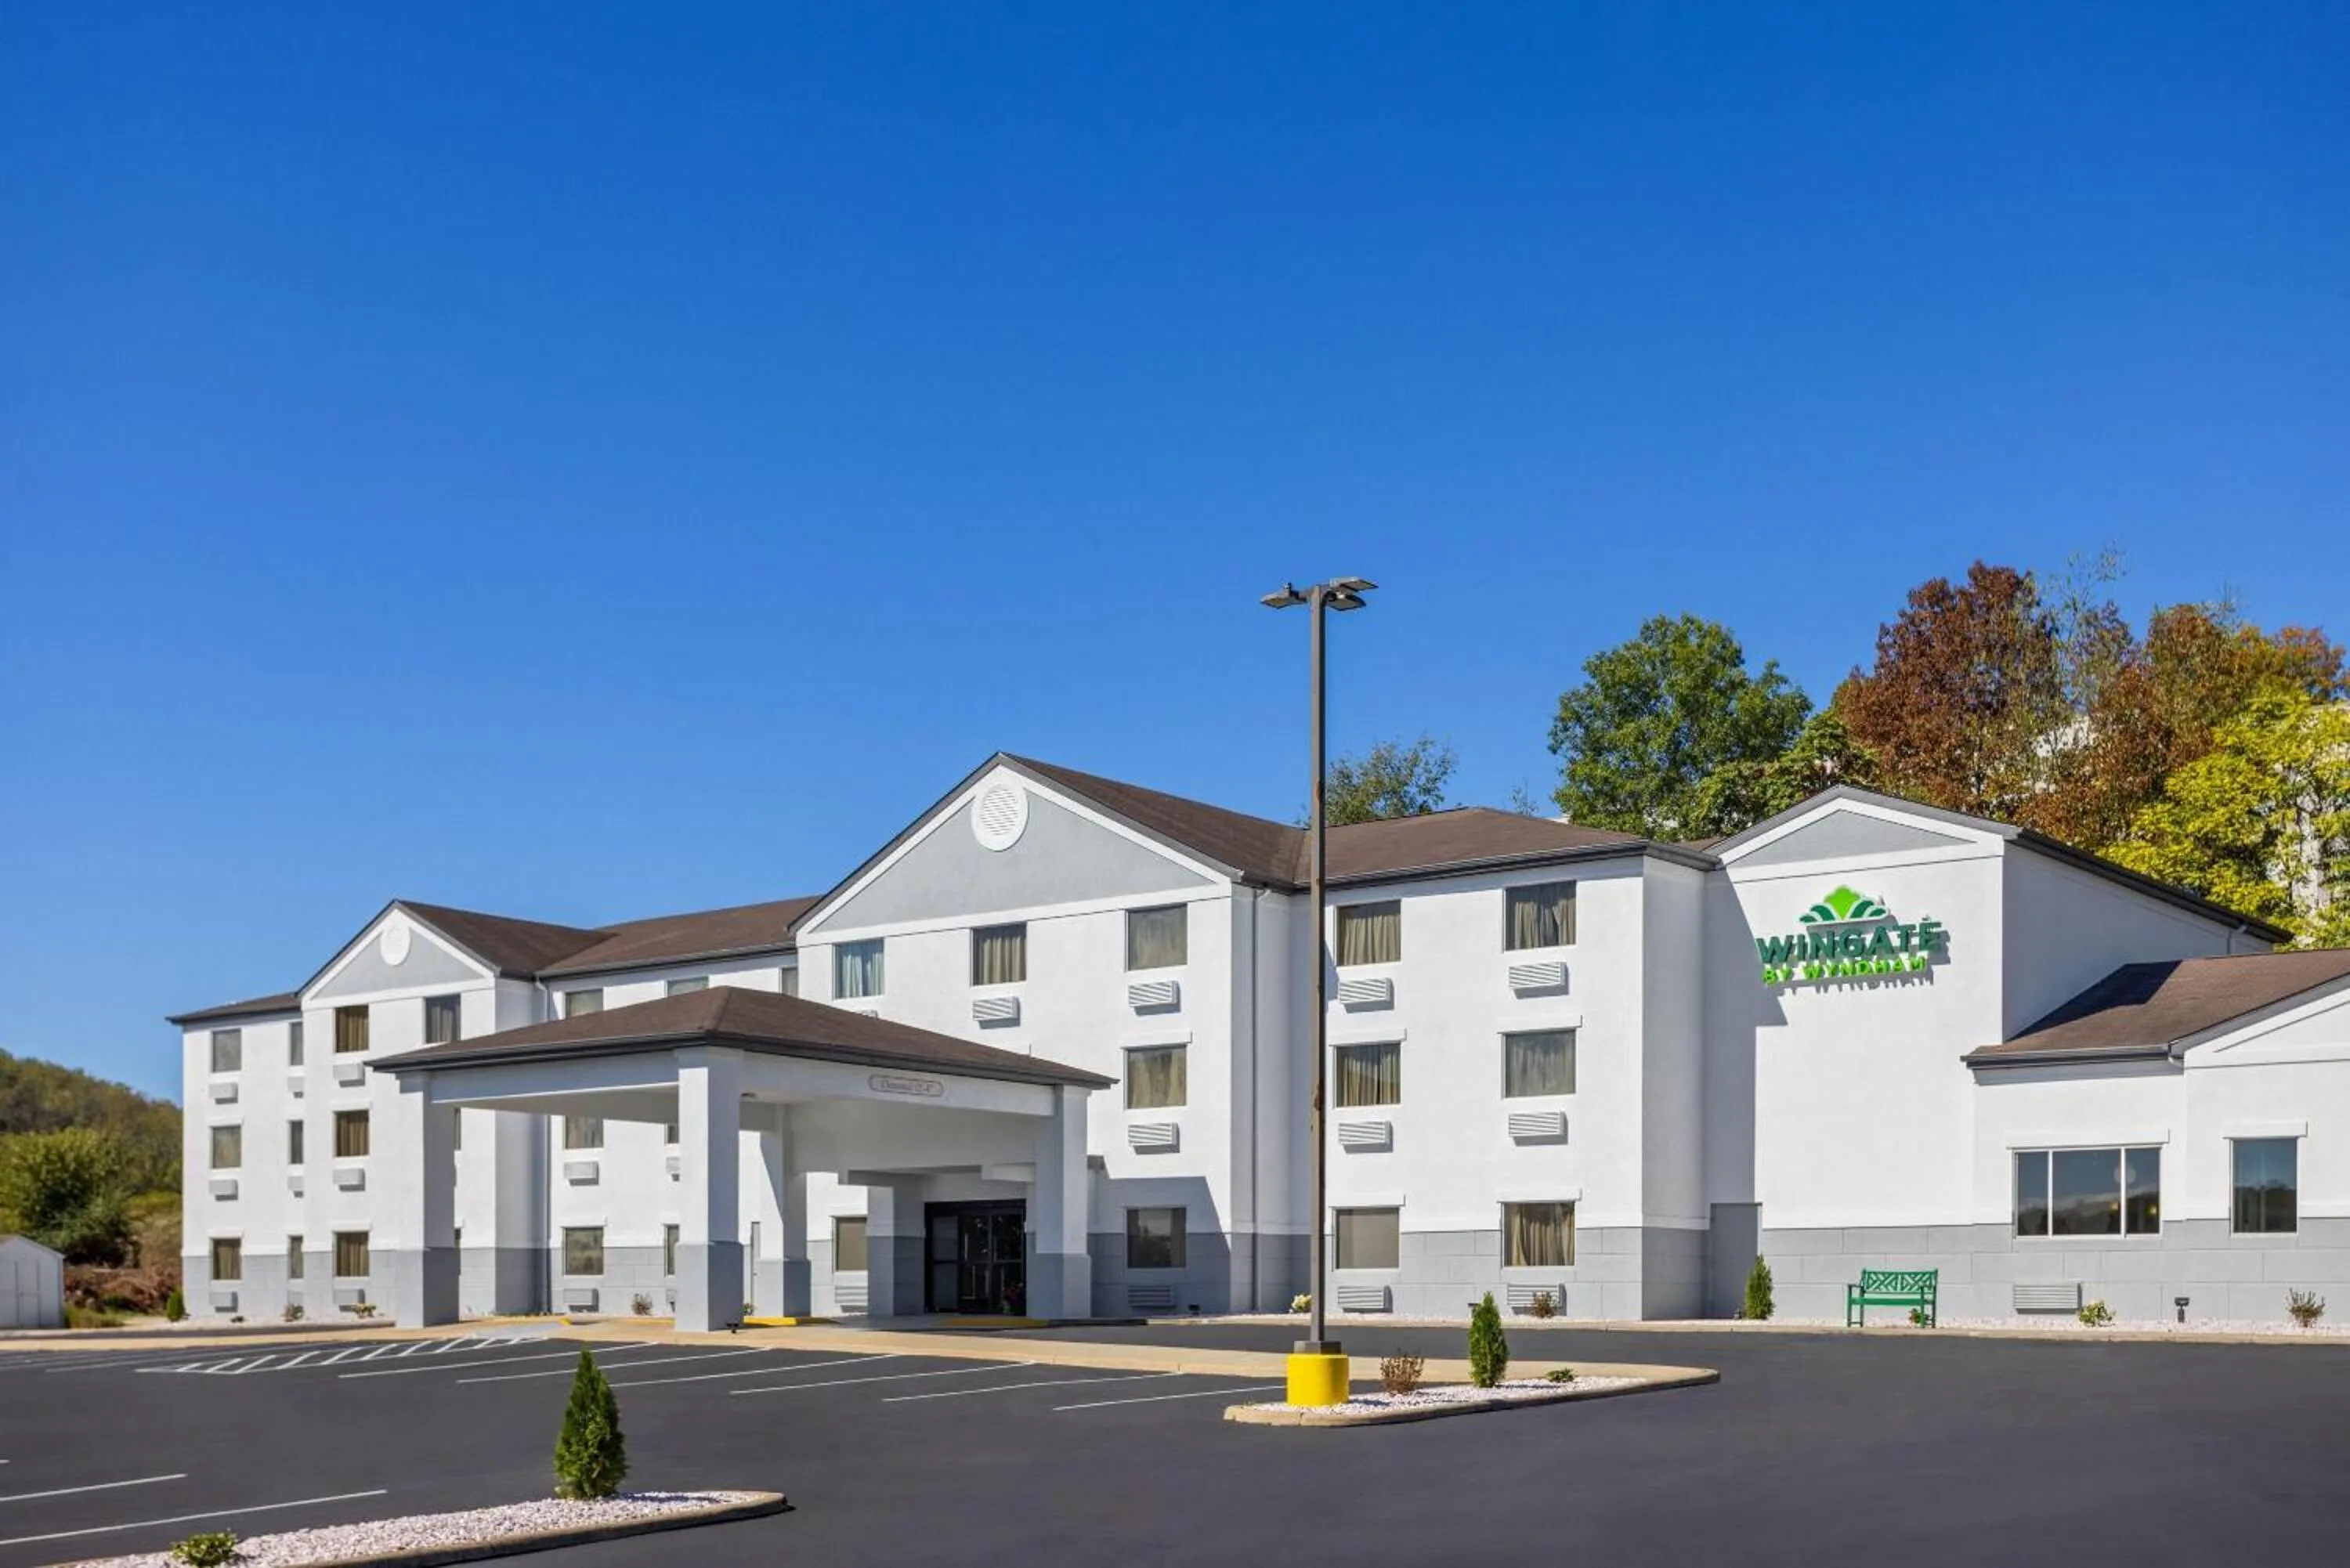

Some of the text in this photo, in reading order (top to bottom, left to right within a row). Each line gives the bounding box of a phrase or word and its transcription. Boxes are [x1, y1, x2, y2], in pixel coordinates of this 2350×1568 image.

[1756, 922, 1943, 963] WINGATE
[1762, 956, 1928, 985] BY WYNDHAM
